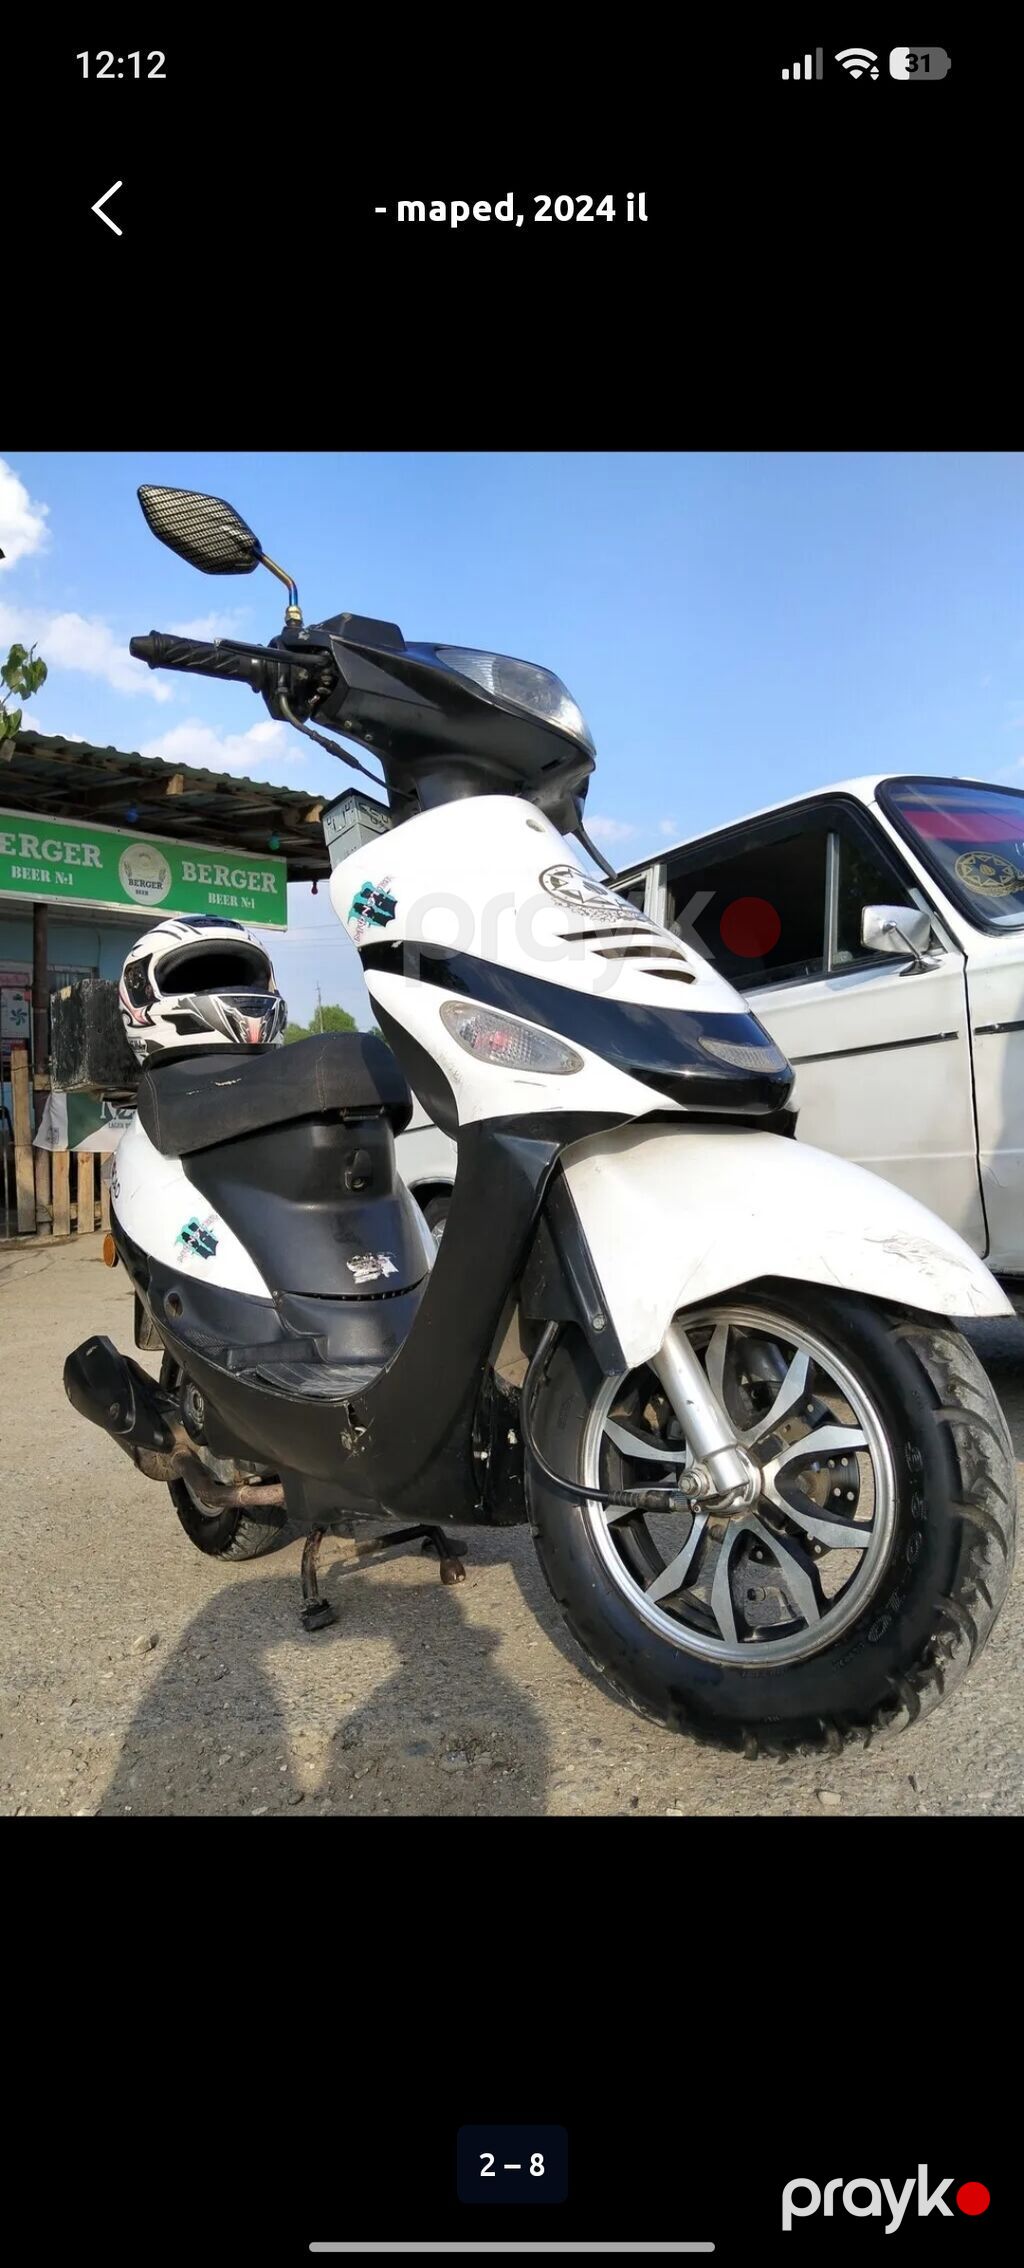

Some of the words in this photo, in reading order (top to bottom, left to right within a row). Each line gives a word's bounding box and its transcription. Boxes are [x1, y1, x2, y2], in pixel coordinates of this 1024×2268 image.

[11, 865, 51, 883] BEER
[181, 860, 278, 894] BERGER
[128, 878, 164, 891] BERGER
[208, 892, 239, 908] BEER
